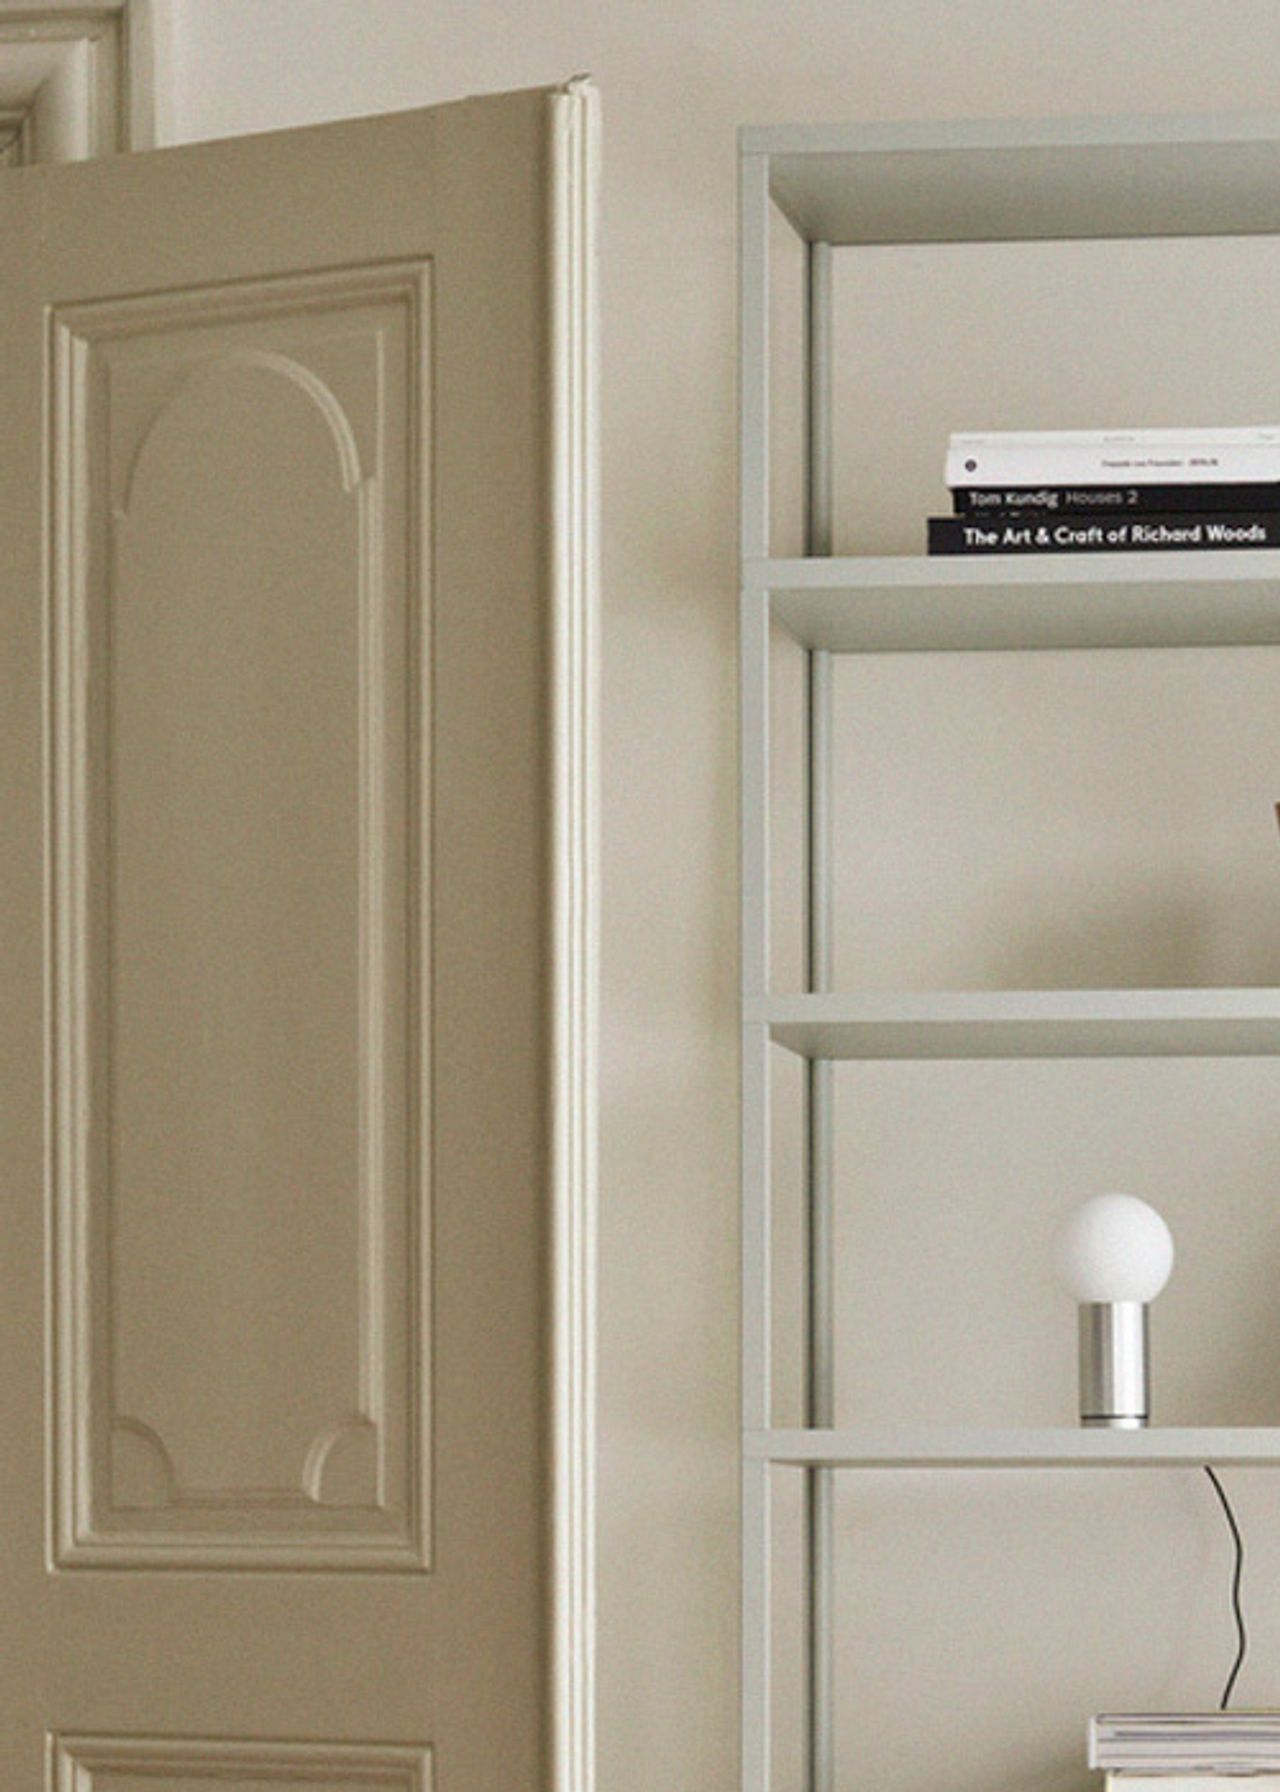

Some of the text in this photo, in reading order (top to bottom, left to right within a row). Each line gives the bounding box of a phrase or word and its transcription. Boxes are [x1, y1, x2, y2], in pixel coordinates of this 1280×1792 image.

[969, 489, 1139, 509] Tom Kundig Houses 2
[964, 524, 1267, 545] The Art & Craft of Richard Woods
